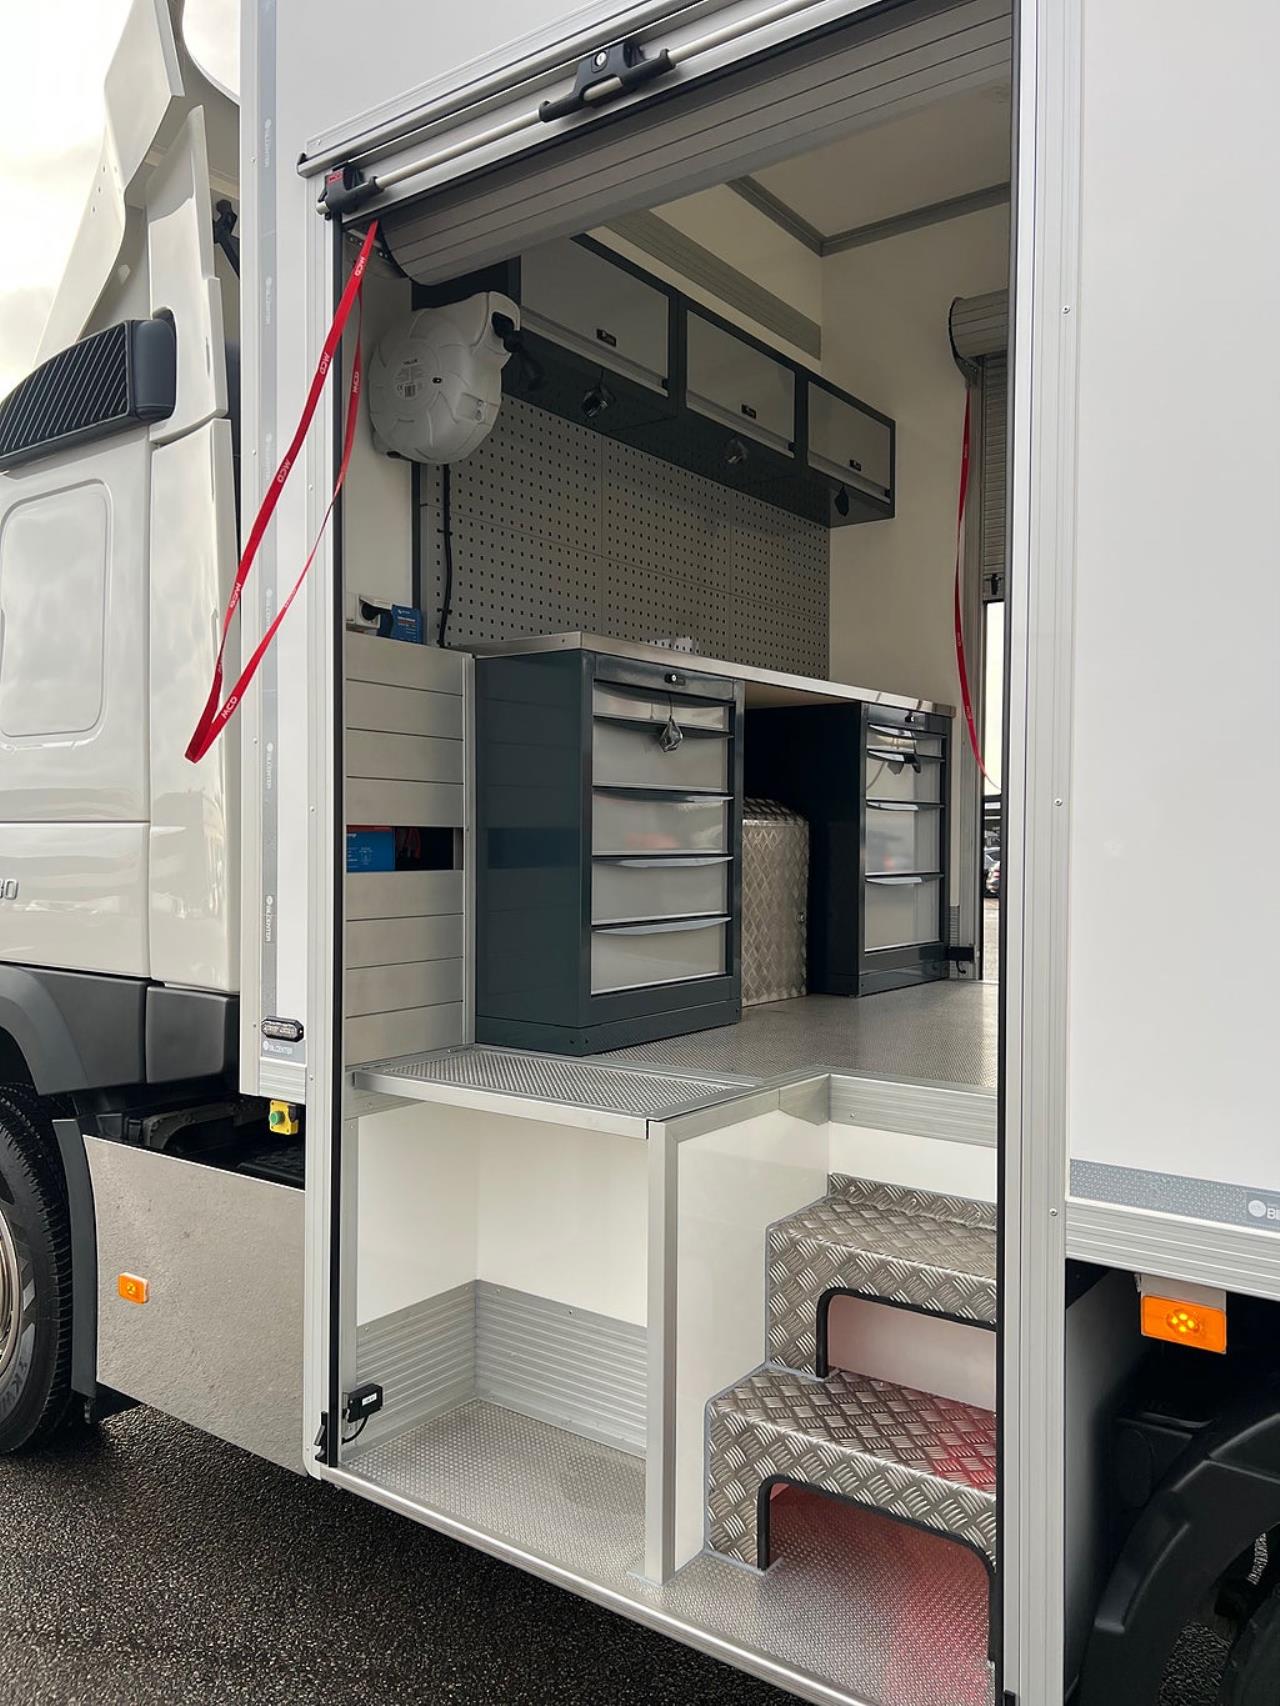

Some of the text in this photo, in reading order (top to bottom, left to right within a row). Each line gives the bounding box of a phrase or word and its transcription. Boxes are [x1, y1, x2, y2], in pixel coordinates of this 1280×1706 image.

[319, 351, 331, 375] MCD
[352, 371, 360, 394] MCD
[276, 459, 292, 484] MCD
[220, 696, 238, 720] MCD
